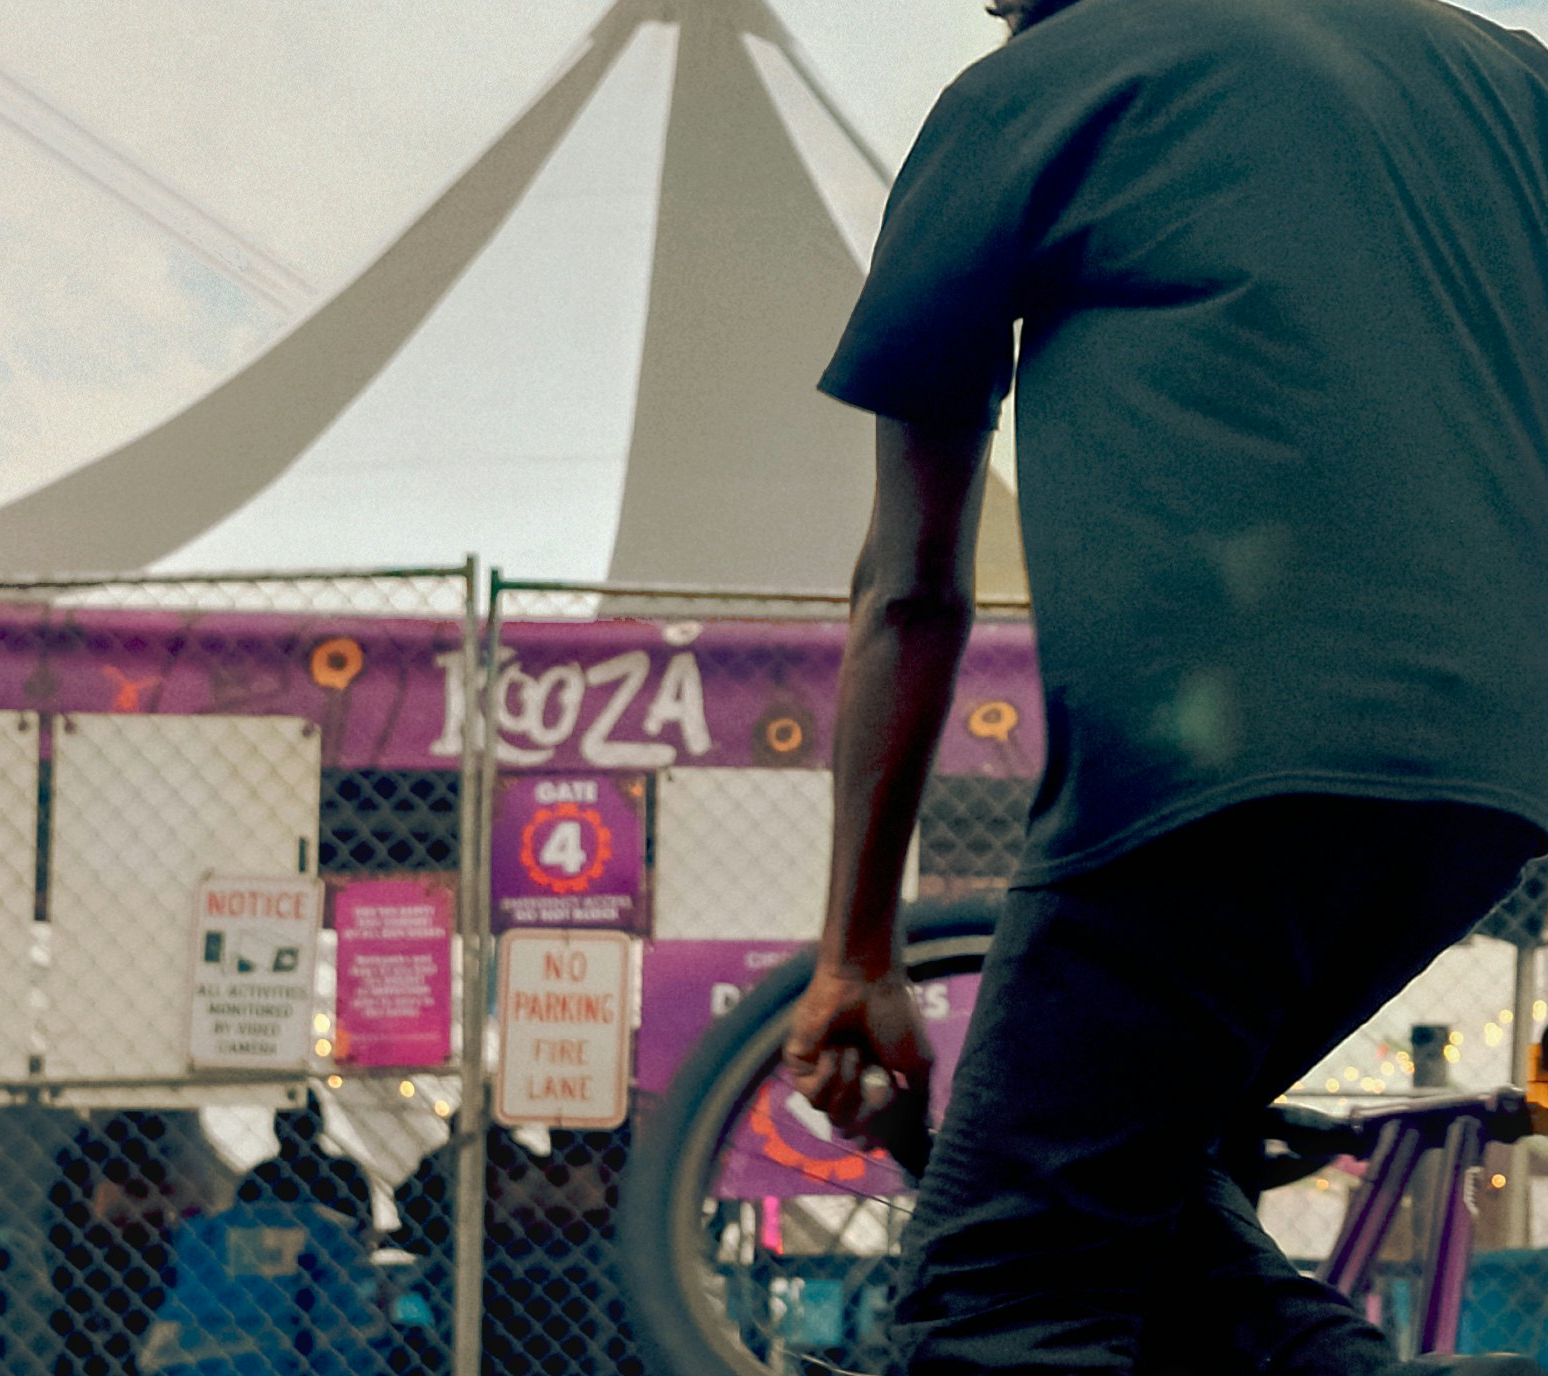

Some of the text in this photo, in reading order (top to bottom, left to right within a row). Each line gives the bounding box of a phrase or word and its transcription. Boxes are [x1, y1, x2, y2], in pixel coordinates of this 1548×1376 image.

[534, 780, 598, 805] GATE
[538, 820, 587, 876] 4
[207, 890, 308, 920] NOTICE
[543, 950, 588, 984] NO
[513, 991, 614, 1024] PARKING
[532, 1038, 588, 1066] FIRE
[526, 1075, 593, 1102] LANE
